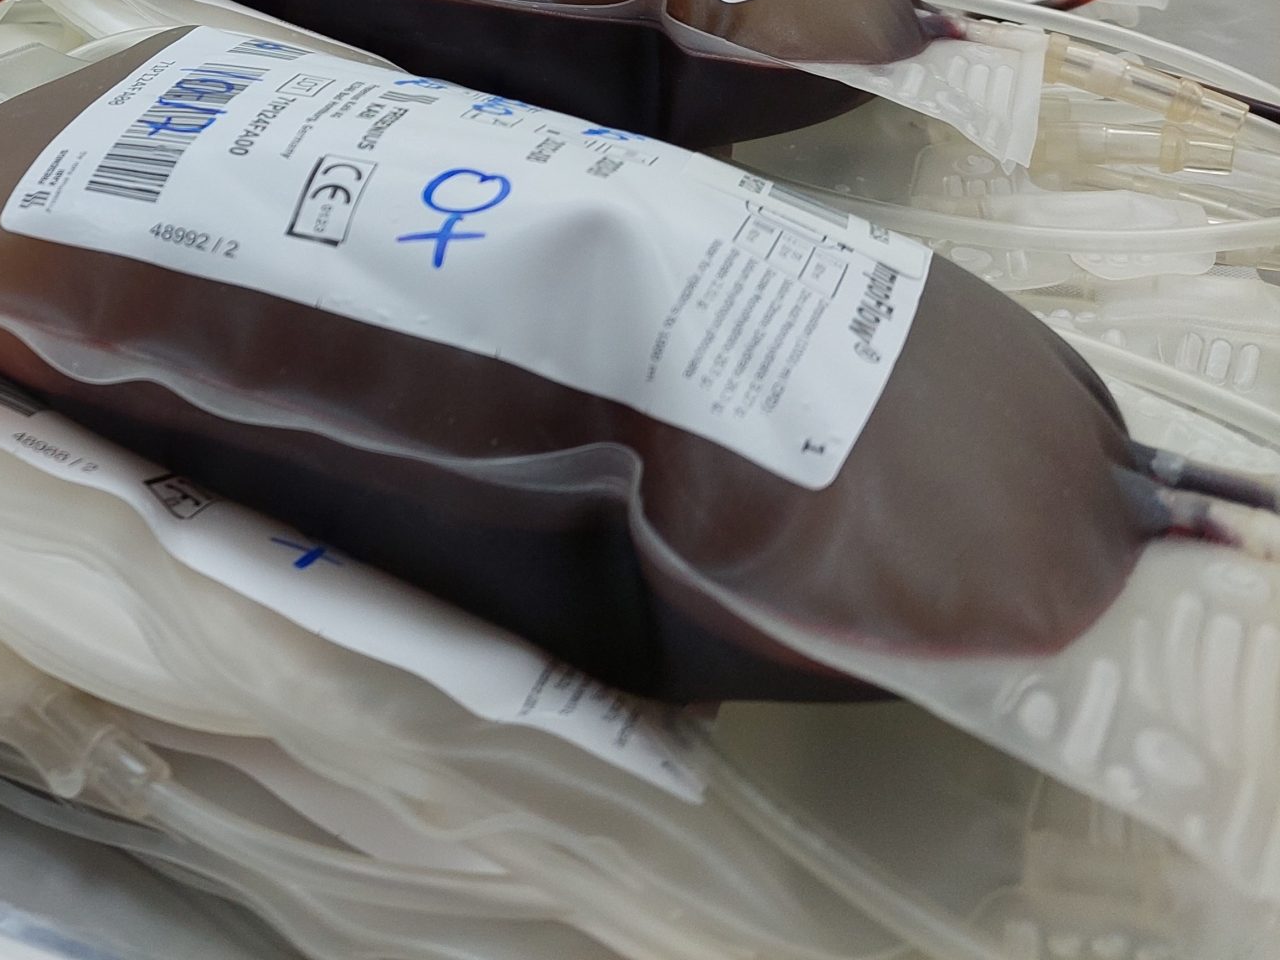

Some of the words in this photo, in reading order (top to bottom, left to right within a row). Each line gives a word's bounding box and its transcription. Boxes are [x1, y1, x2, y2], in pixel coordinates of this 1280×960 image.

[308, 162, 365, 207] CE
[395, 166, 512, 269] O+
[148, 220, 212, 250] 48992
[223, 239, 242, 260] 2
[801, 439, 826, 455] 1
